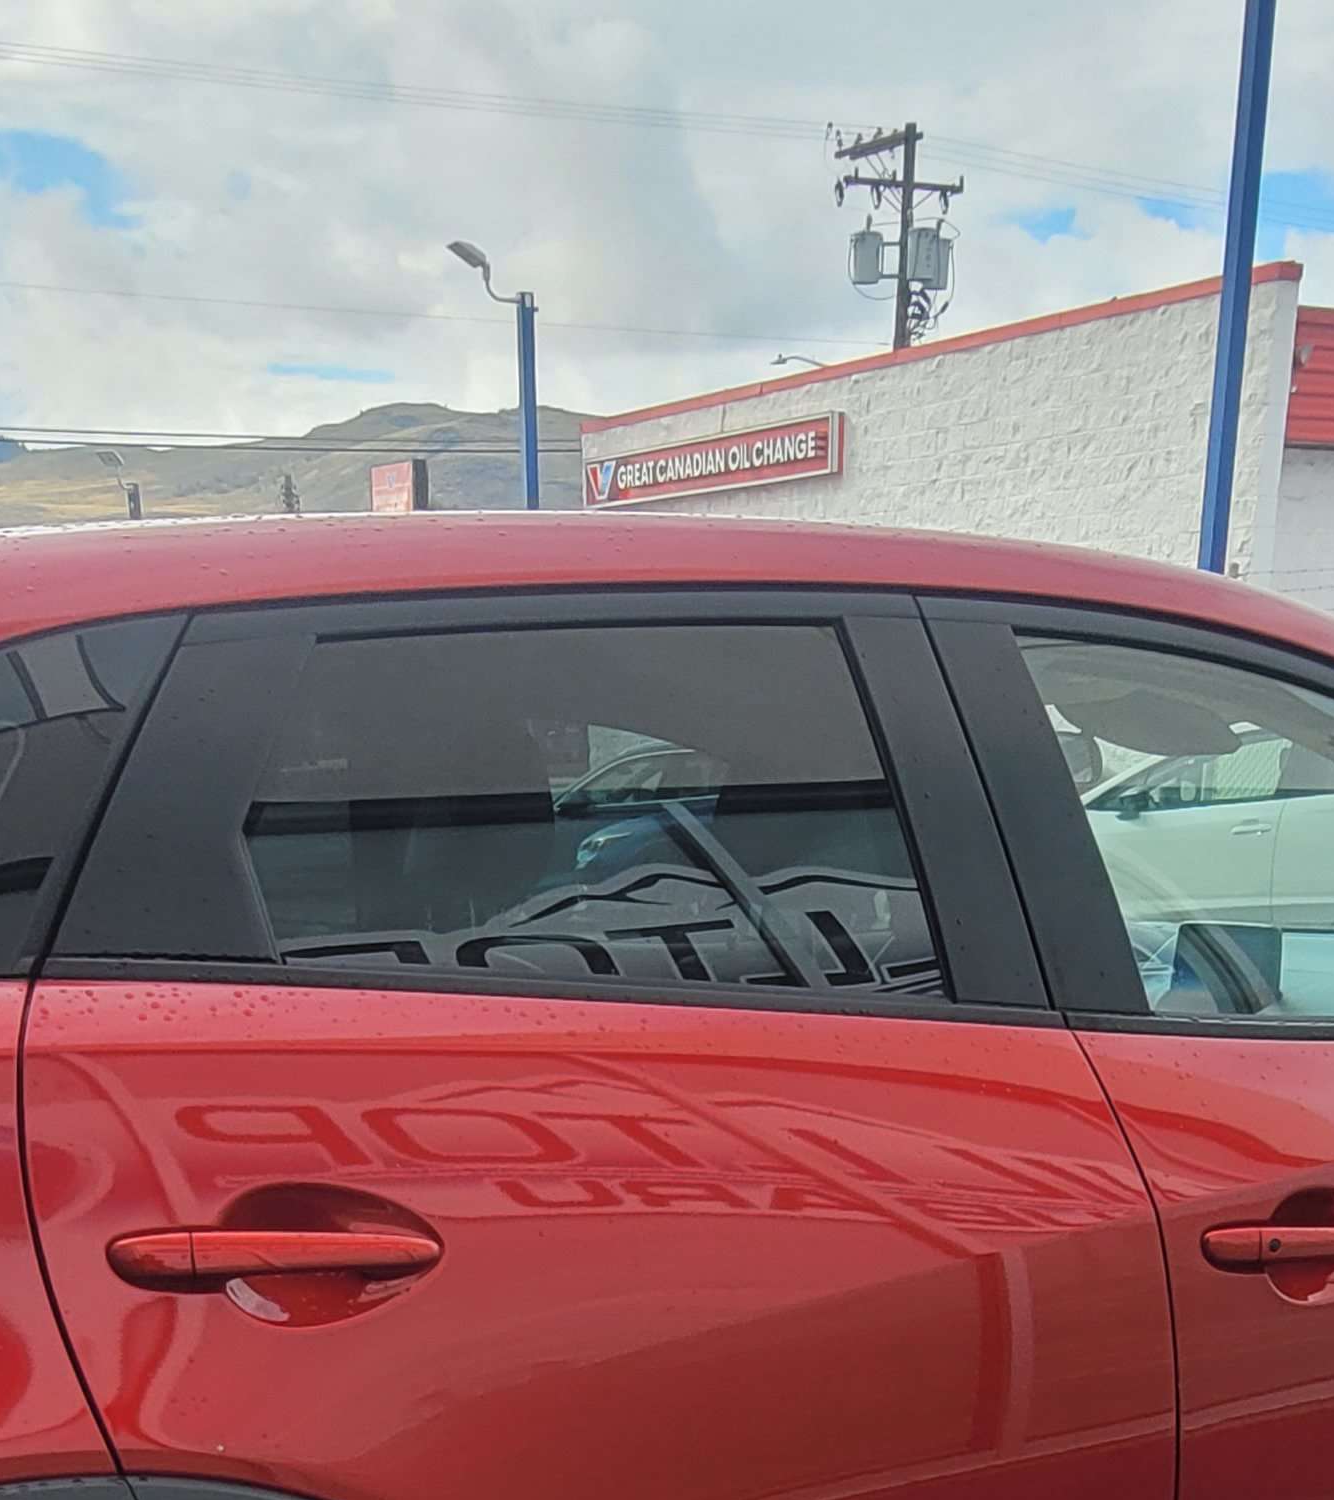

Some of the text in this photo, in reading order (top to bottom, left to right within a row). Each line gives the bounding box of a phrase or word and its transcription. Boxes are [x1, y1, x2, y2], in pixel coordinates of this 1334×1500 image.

[617, 431, 816, 490] GREAT CANADIAN OIL CHANGE
